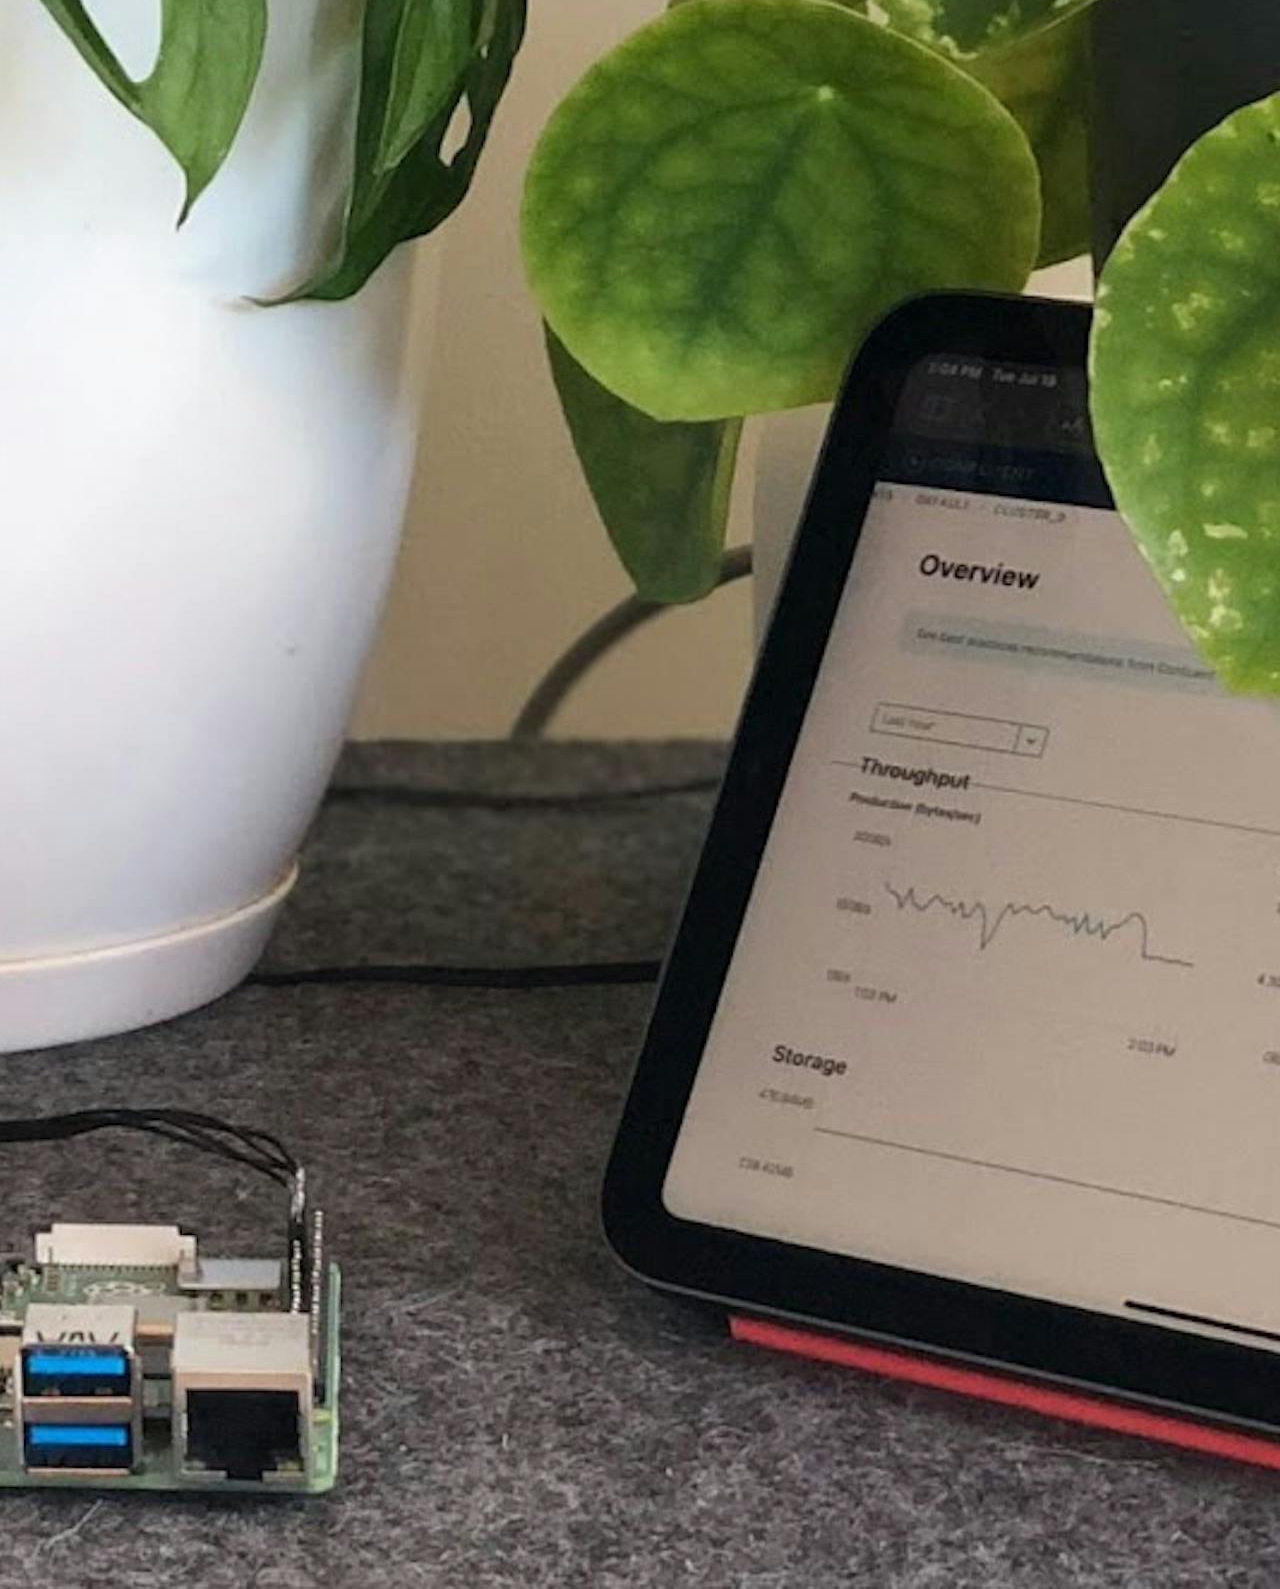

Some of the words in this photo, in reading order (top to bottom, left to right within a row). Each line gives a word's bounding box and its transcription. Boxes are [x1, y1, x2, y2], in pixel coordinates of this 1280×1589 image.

[919, 554, 1041, 590] Overview
[860, 756, 972, 791] Throughput
[849, 791, 913, 812] Production
[771, 1043, 848, 1077] Storage
[1155, 1041, 1177, 1058] PM
